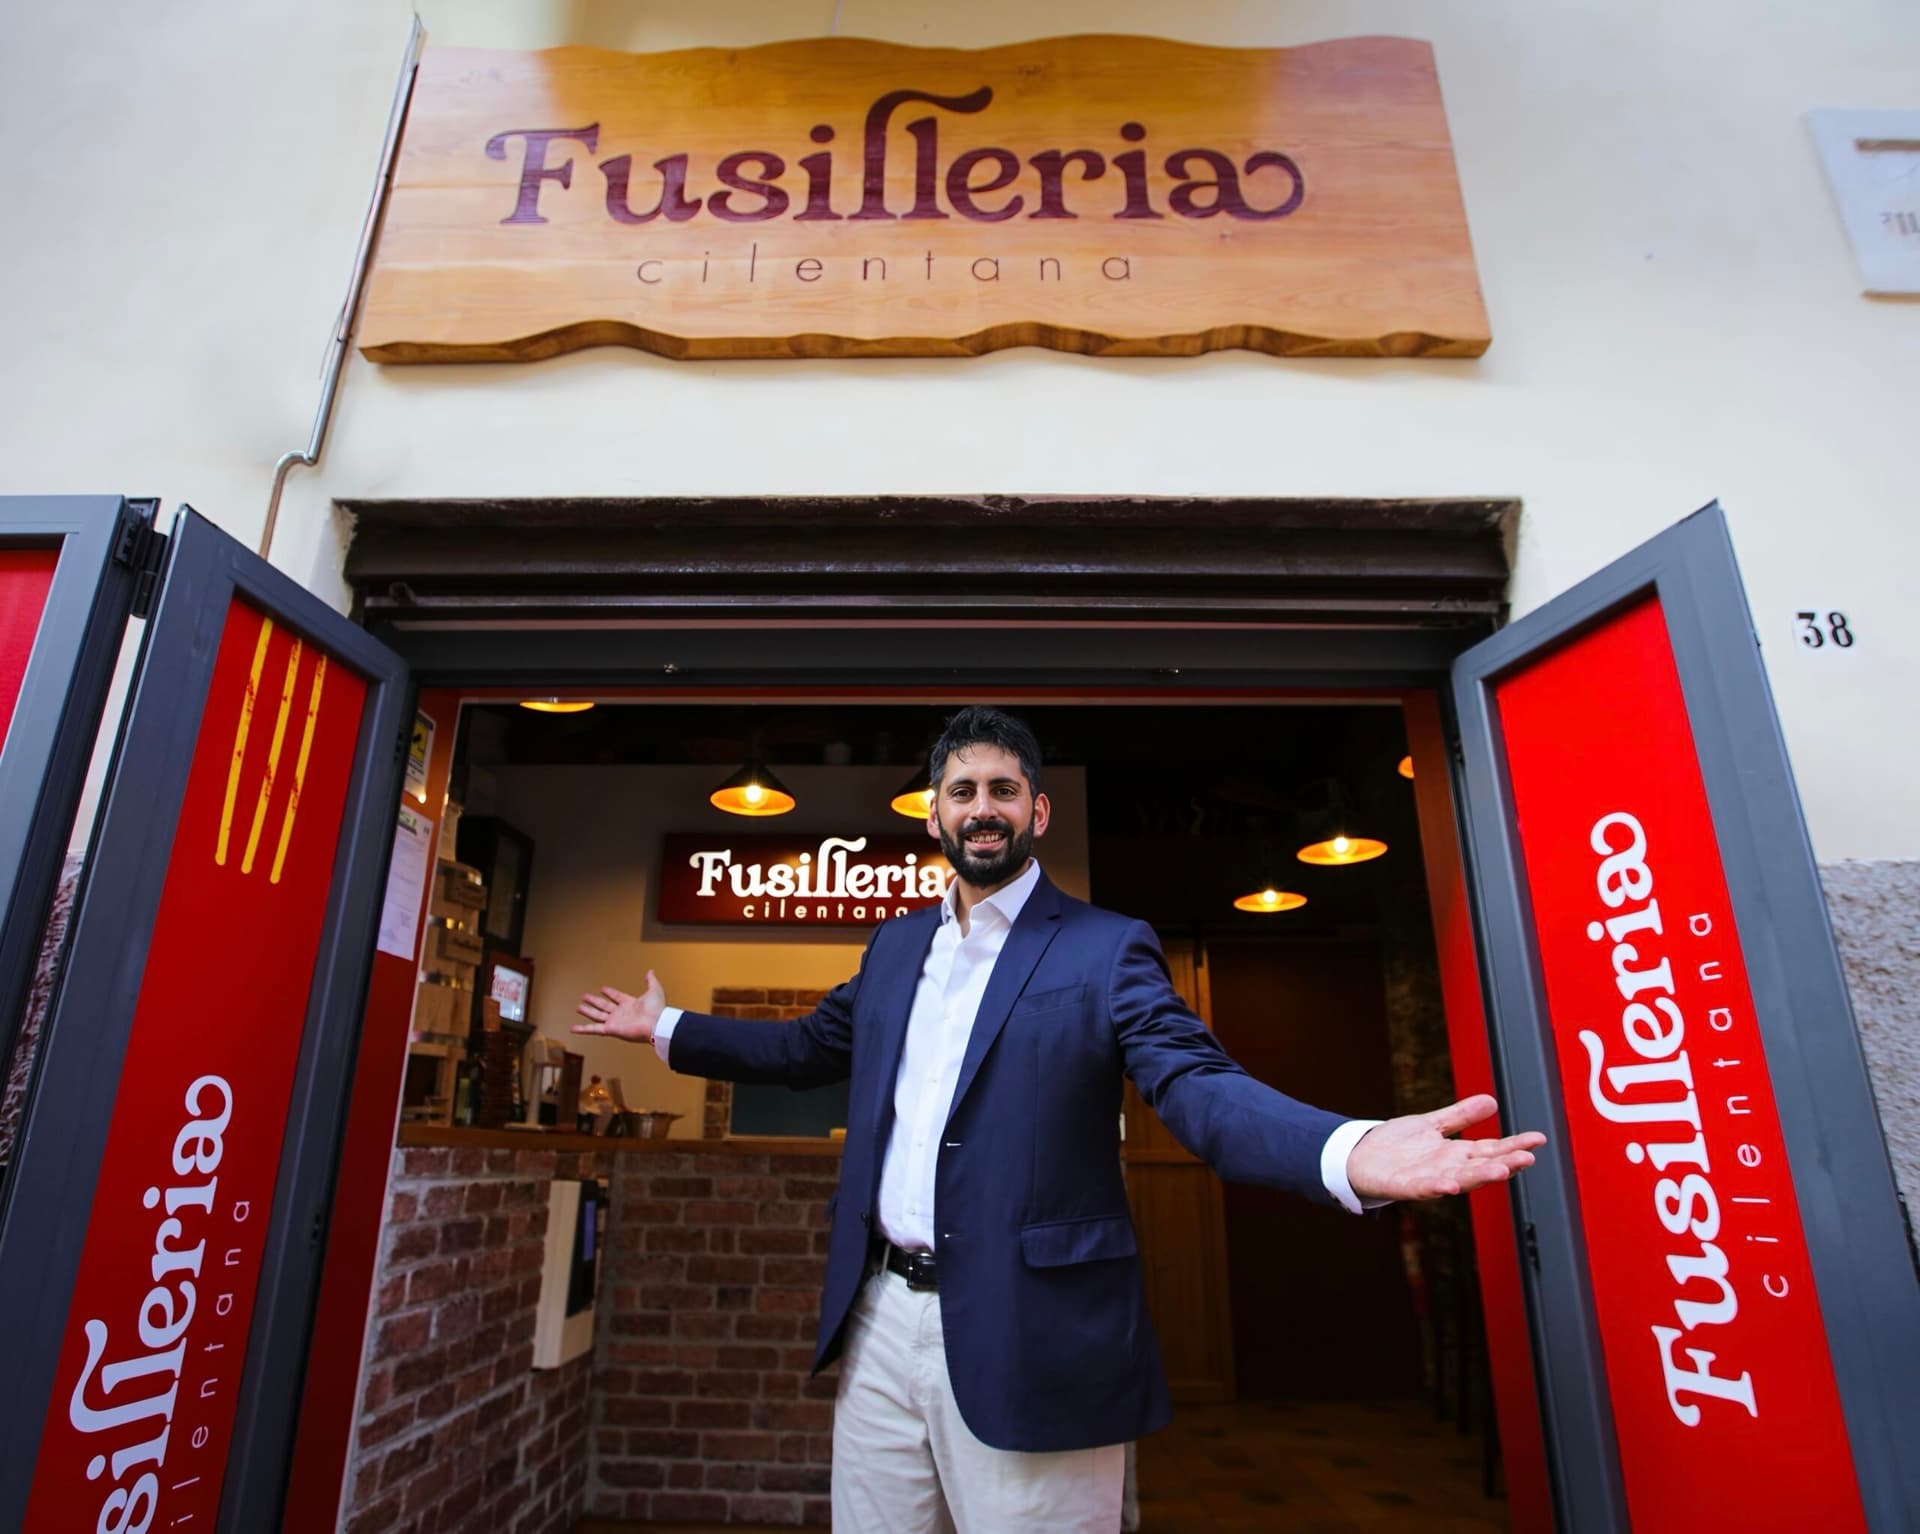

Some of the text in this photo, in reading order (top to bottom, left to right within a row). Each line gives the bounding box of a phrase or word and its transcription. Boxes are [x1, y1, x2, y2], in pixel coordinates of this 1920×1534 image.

[485, 86, 1305, 224] Fusilleria
[636, 242, 1132, 284] cilentana
[1797, 611, 1854, 648] 38
[689, 836, 957, 899] Fusilleria
[1578, 811, 1759, 1428] Fusilleria
[1689, 912, 1789, 1298] cilentana
[69, 1074, 233, 1534] silleria
[169, 1200, 250, 1527] ilentana
